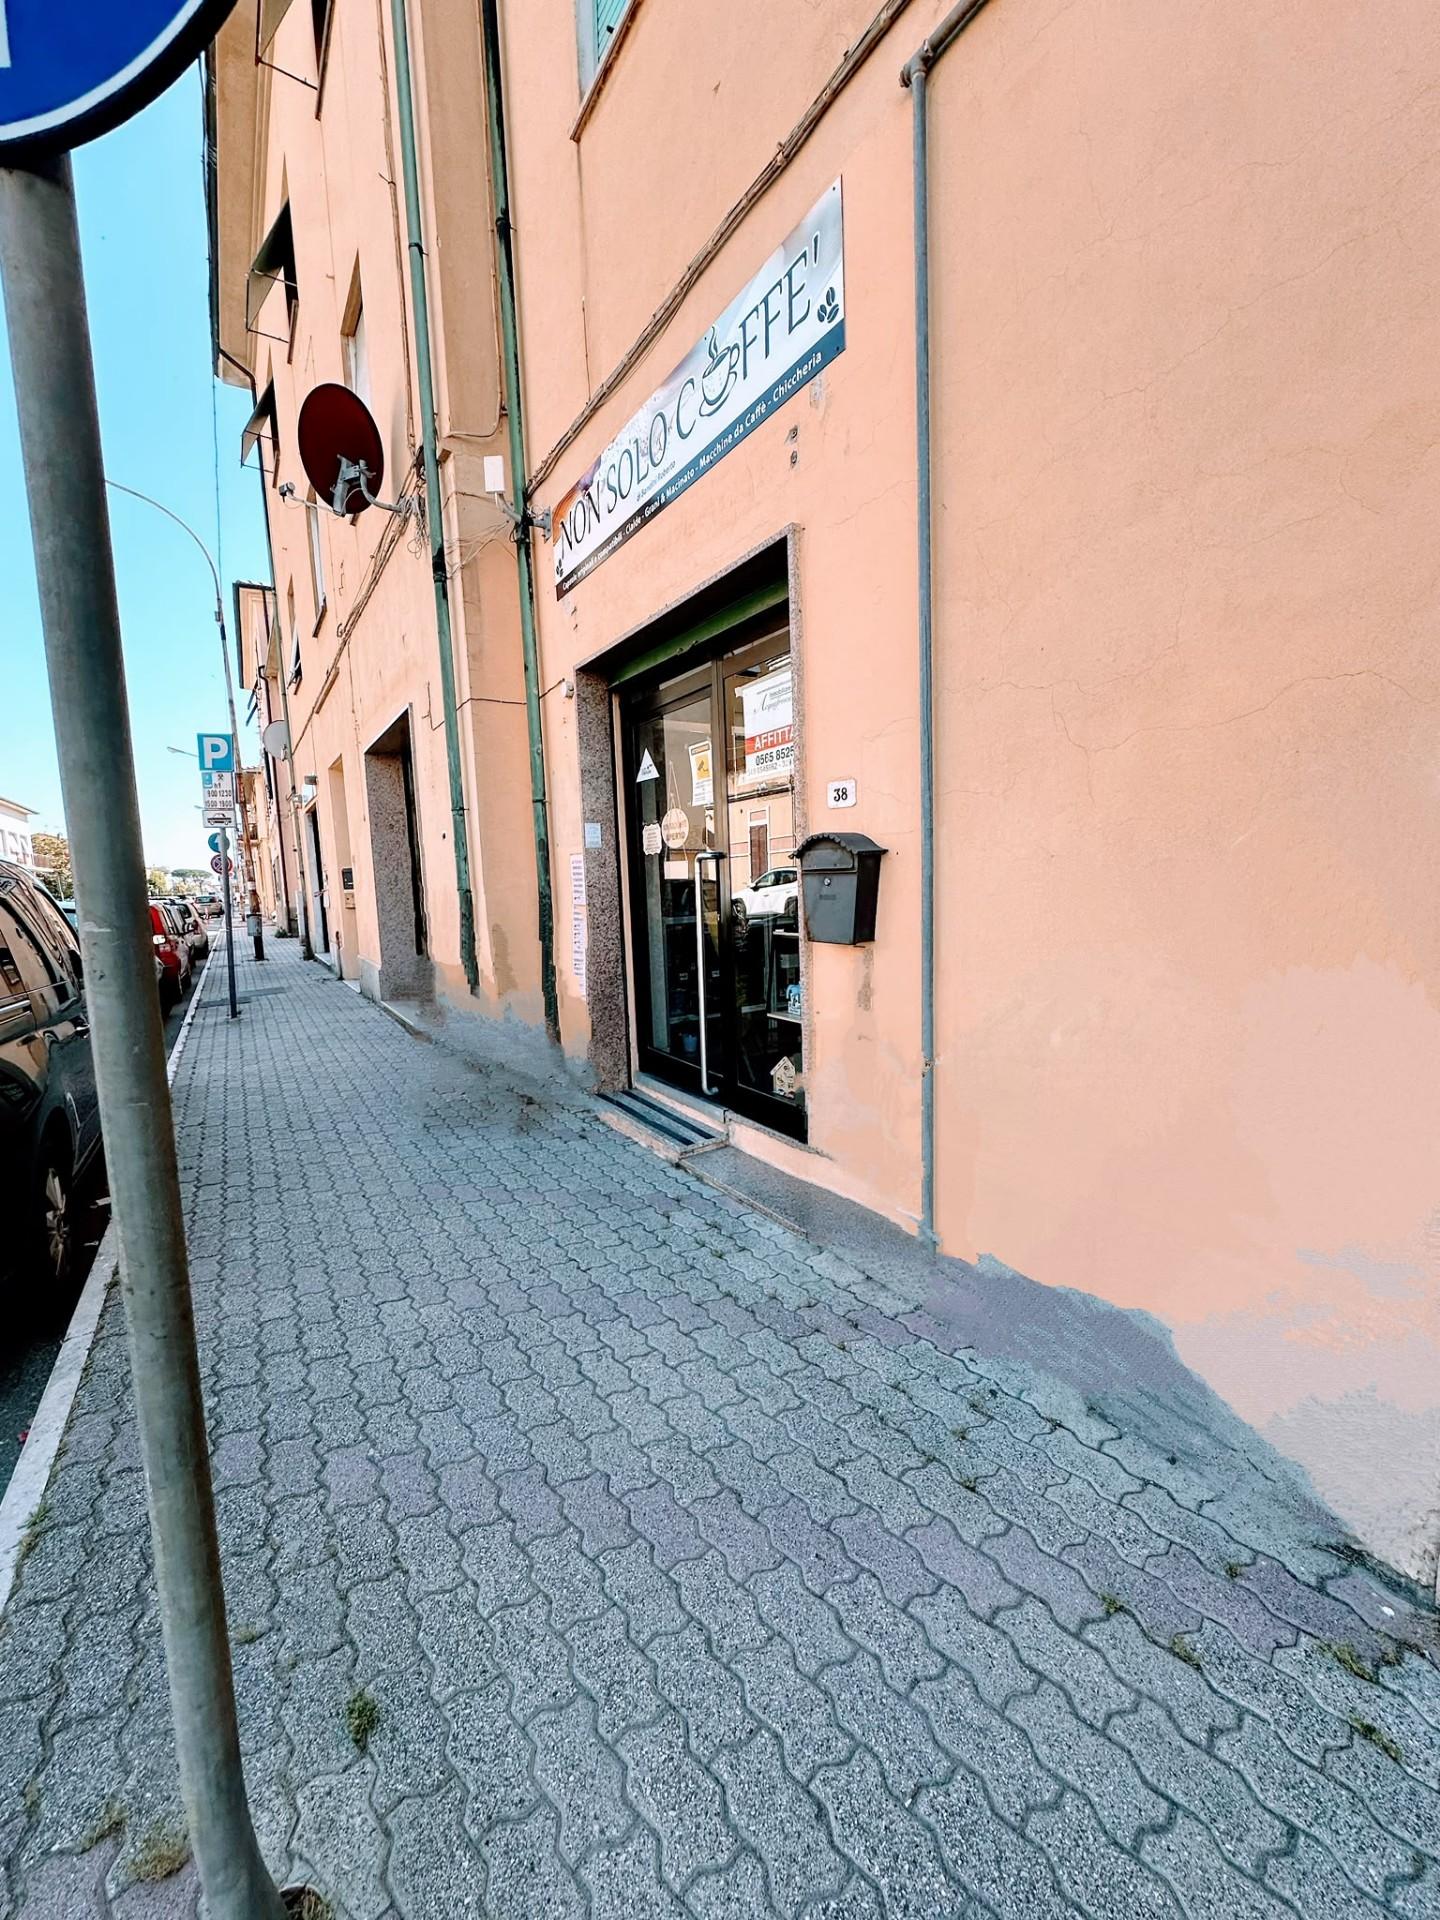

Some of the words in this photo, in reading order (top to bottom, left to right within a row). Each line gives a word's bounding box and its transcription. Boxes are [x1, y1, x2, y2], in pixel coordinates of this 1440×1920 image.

[625, 513, 642, 535] Cialde
[644, 496, 660, 517] Grani
[660, 492, 667, 504] &
[666, 467, 696, 499] Macinato
[699, 434, 733, 470] Macchine
[733, 423, 745, 438] da
[745, 402, 767, 427] Caffè
[772, 349, 823, 403] Chiccheria
[561, 478, 601, 560] NON
[606, 411, 668, 514] SOLO
[202, 736, 229, 769] P
[755, 751, 774, 766] 0565
[833, 786, 848, 802] 38
